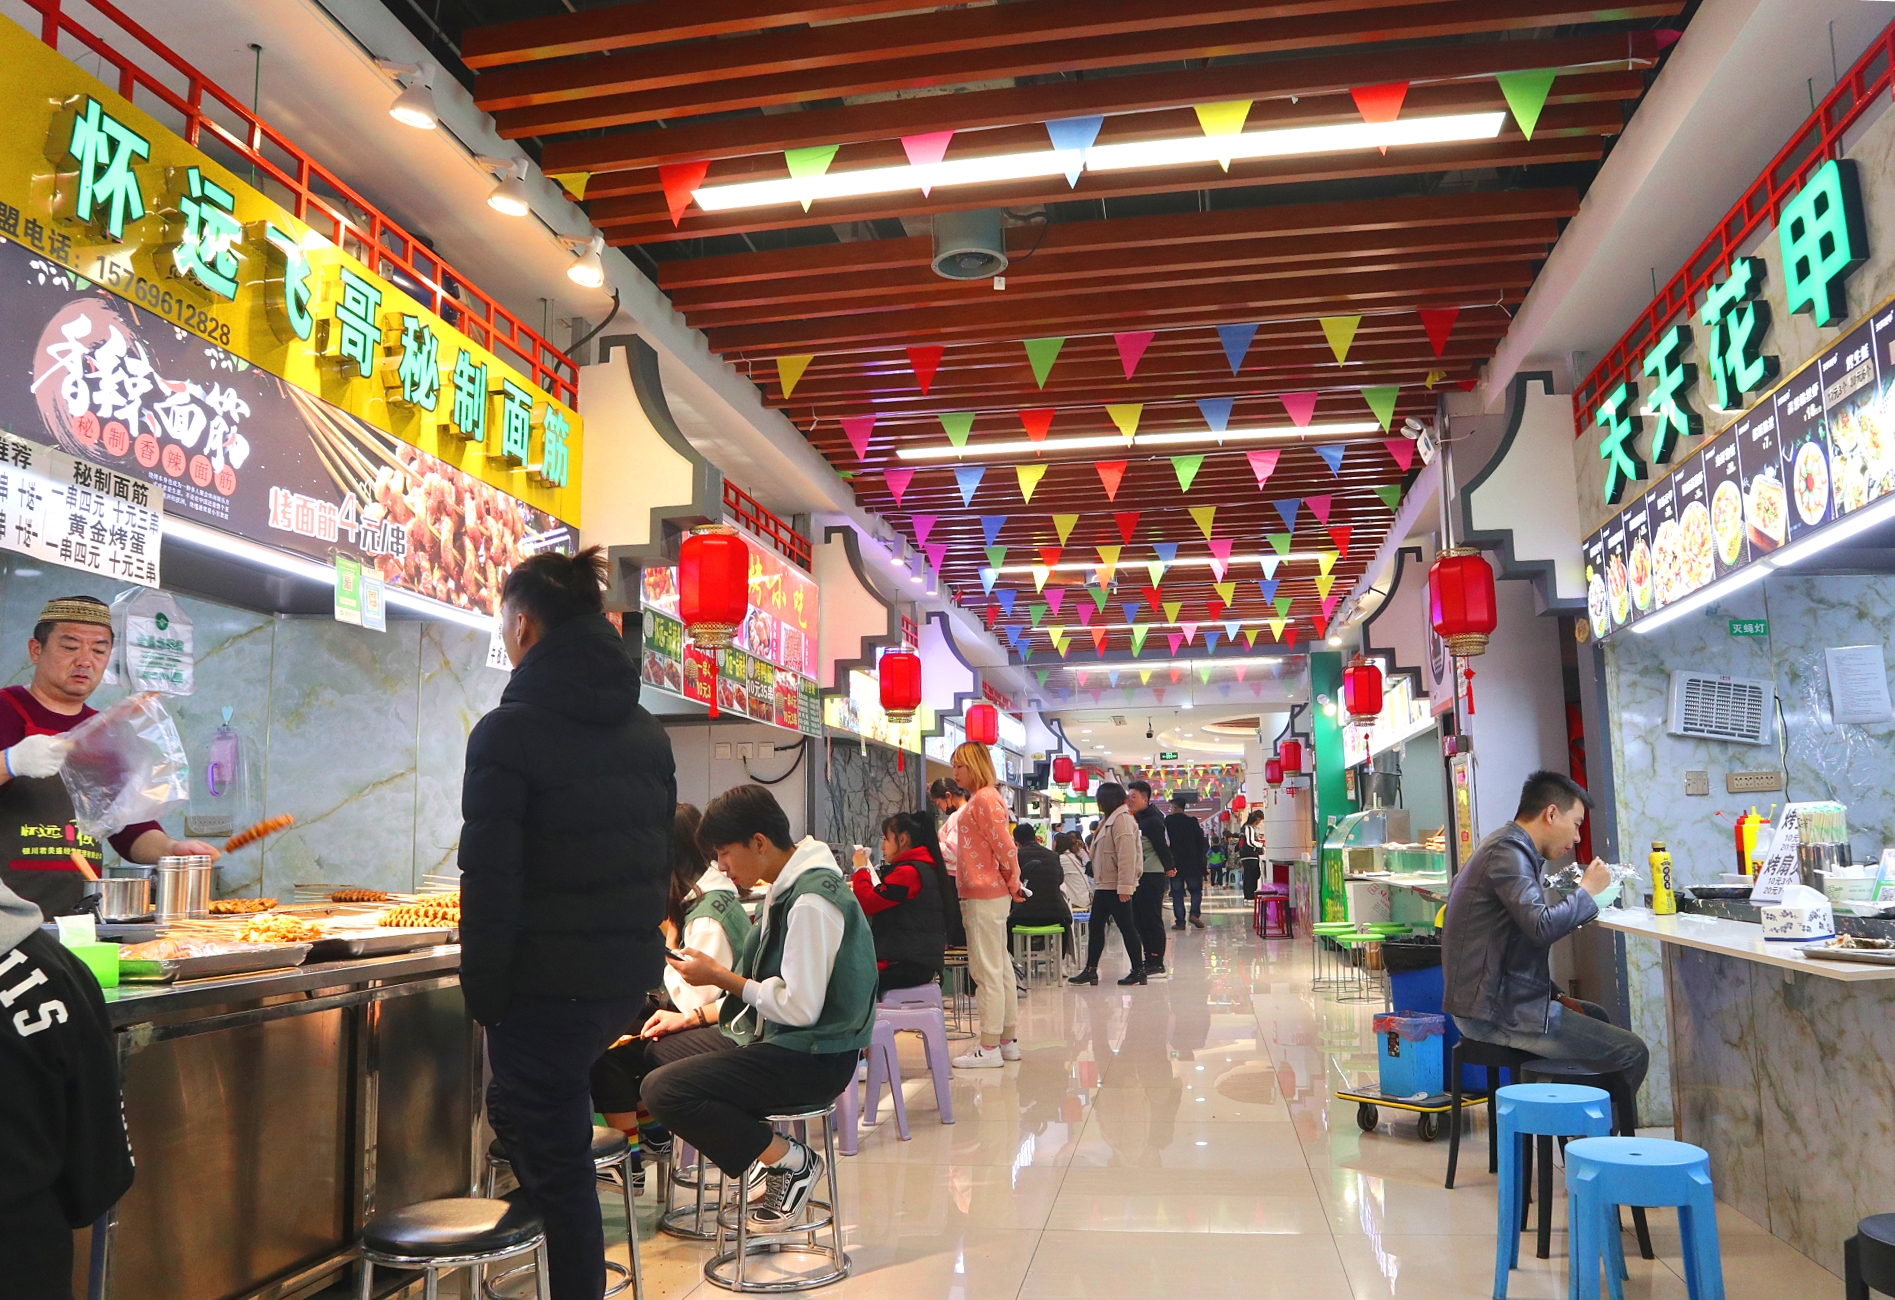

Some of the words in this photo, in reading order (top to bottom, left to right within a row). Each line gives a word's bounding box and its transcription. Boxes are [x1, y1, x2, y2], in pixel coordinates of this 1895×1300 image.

[69, 97, 570, 489] 怀远飞哥秘制面筋
[1596, 159, 1851, 505] 天天花甲
[78, 416, 232, 491] 秘制香辣面筋
[73, 461, 149, 507] 秘制面筋
[52, 485, 105, 518] 一串四元
[113, 501, 159, 535] 十元三串
[68, 513, 145, 555] 黄金烤蛋
[46, 537, 101, 569] 一串四元
[109, 551, 156, 583] 十元三串
[1732, 623, 1765, 634] 灭蝇灯
